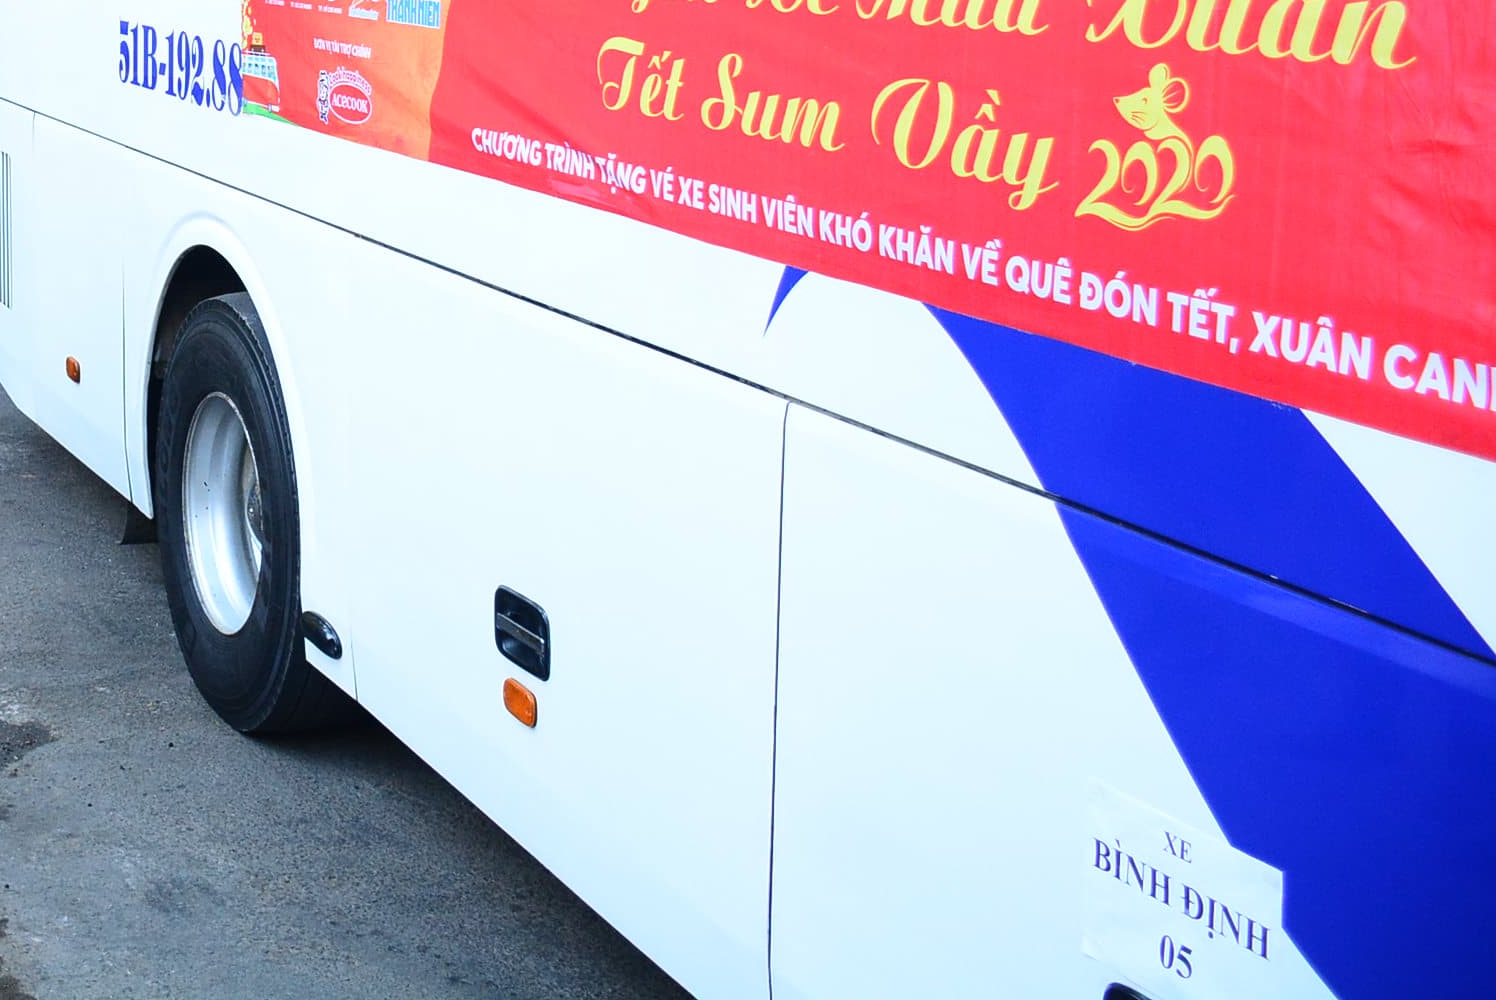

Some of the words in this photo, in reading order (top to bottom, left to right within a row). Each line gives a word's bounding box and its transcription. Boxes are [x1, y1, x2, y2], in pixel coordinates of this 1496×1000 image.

[119, 19, 243, 117] 51B-192.88
[596, 36, 685, 121] Tết
[700, 53, 845, 152] Sum
[870, 78, 1059, 211] Vầy
[1074, 135, 1236, 231] 2020
[471, 127, 542, 166] CHƯƠNG
[544, 141, 595, 180] TRÌNH
[595, 153, 646, 194] TẶNG
[650, 166, 674, 202] VÉ
[678, 175, 705, 210] XE
[708, 183, 757, 224] SINH
[761, 194, 813, 239] VIÊN
[819, 211, 873, 252] KHÓ
[879, 224, 954, 275] KHĂN
[961, 238, 1002, 287] VỀ
[1006, 255, 1072, 305] QUÊ
[1079, 271, 1157, 327] ĐÓN
[1167, 287, 1239, 354] TẾT,
[1248, 311, 1372, 380] XUÂN
[1162, 831, 1193, 864] XE
[1092, 836, 1171, 907] BÌNH
[1181, 883, 1271, 961] ĐỊNH
[1159, 934, 1193, 979] 05
